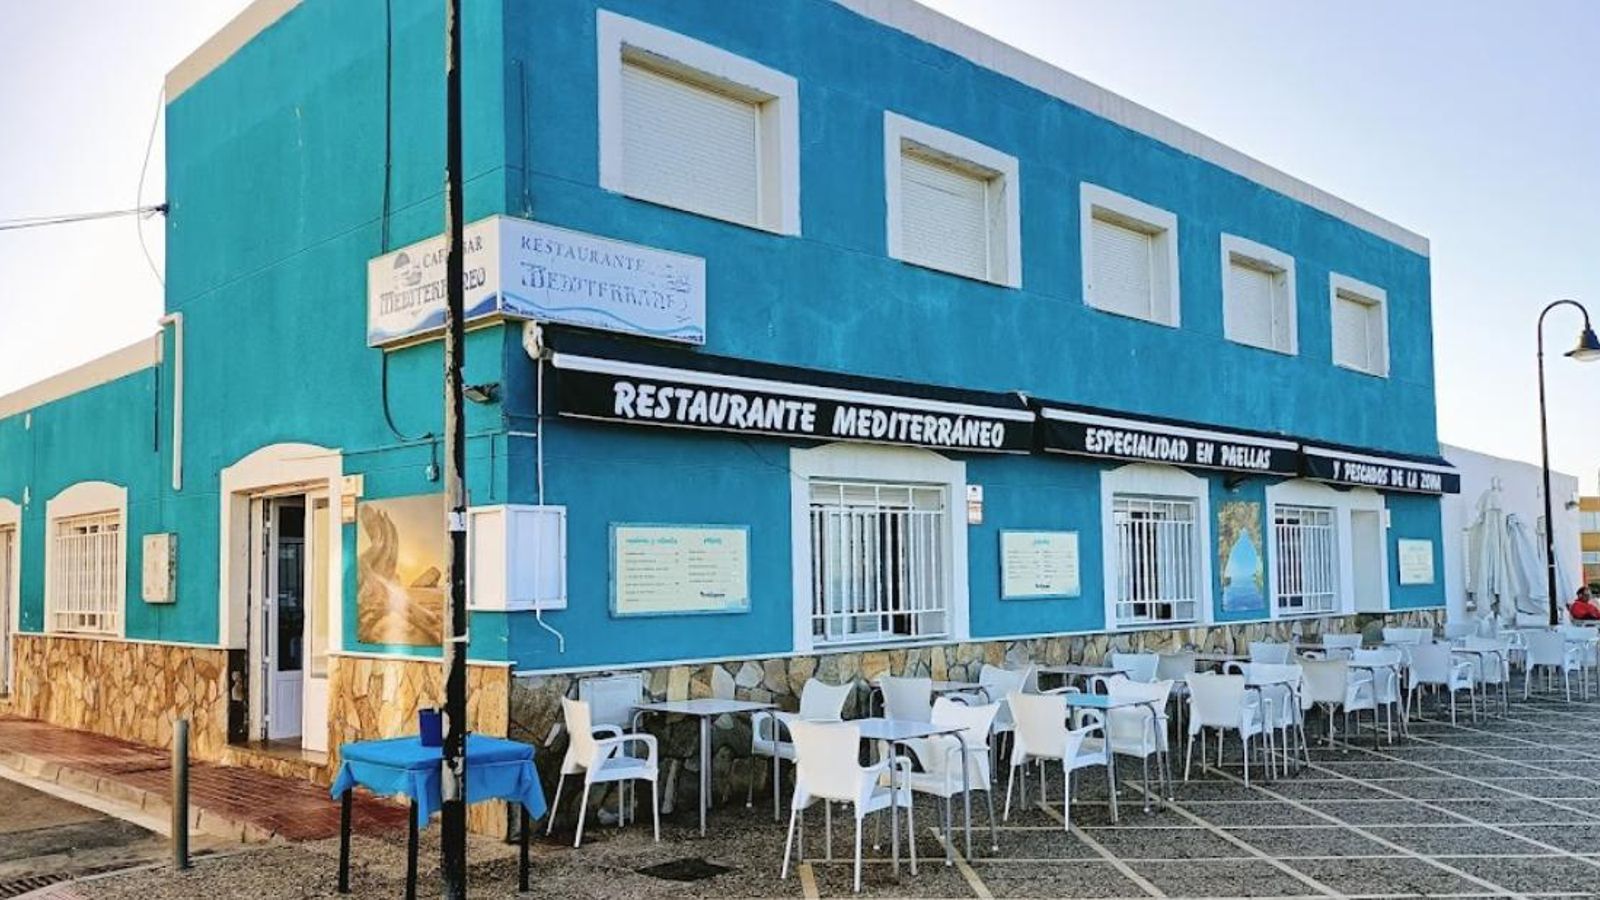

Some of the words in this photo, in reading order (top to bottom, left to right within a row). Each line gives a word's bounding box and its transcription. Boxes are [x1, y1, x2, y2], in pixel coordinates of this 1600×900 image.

[521, 236, 645, 271] RESTAURANTE
[613, 382, 815, 432] RESTAURANTE
[832, 404, 1005, 448] MEDITERRÁNEO
[1085, 428, 1188, 463] ESPECIALIDAD
[1196, 442, 1214, 464] EN
[1221, 445, 1271, 469] PAELLAS
[1344, 462, 1388, 485] PESCADOS
[1391, 469, 1404, 486] DE
[1407, 471, 1418, 488] LA
